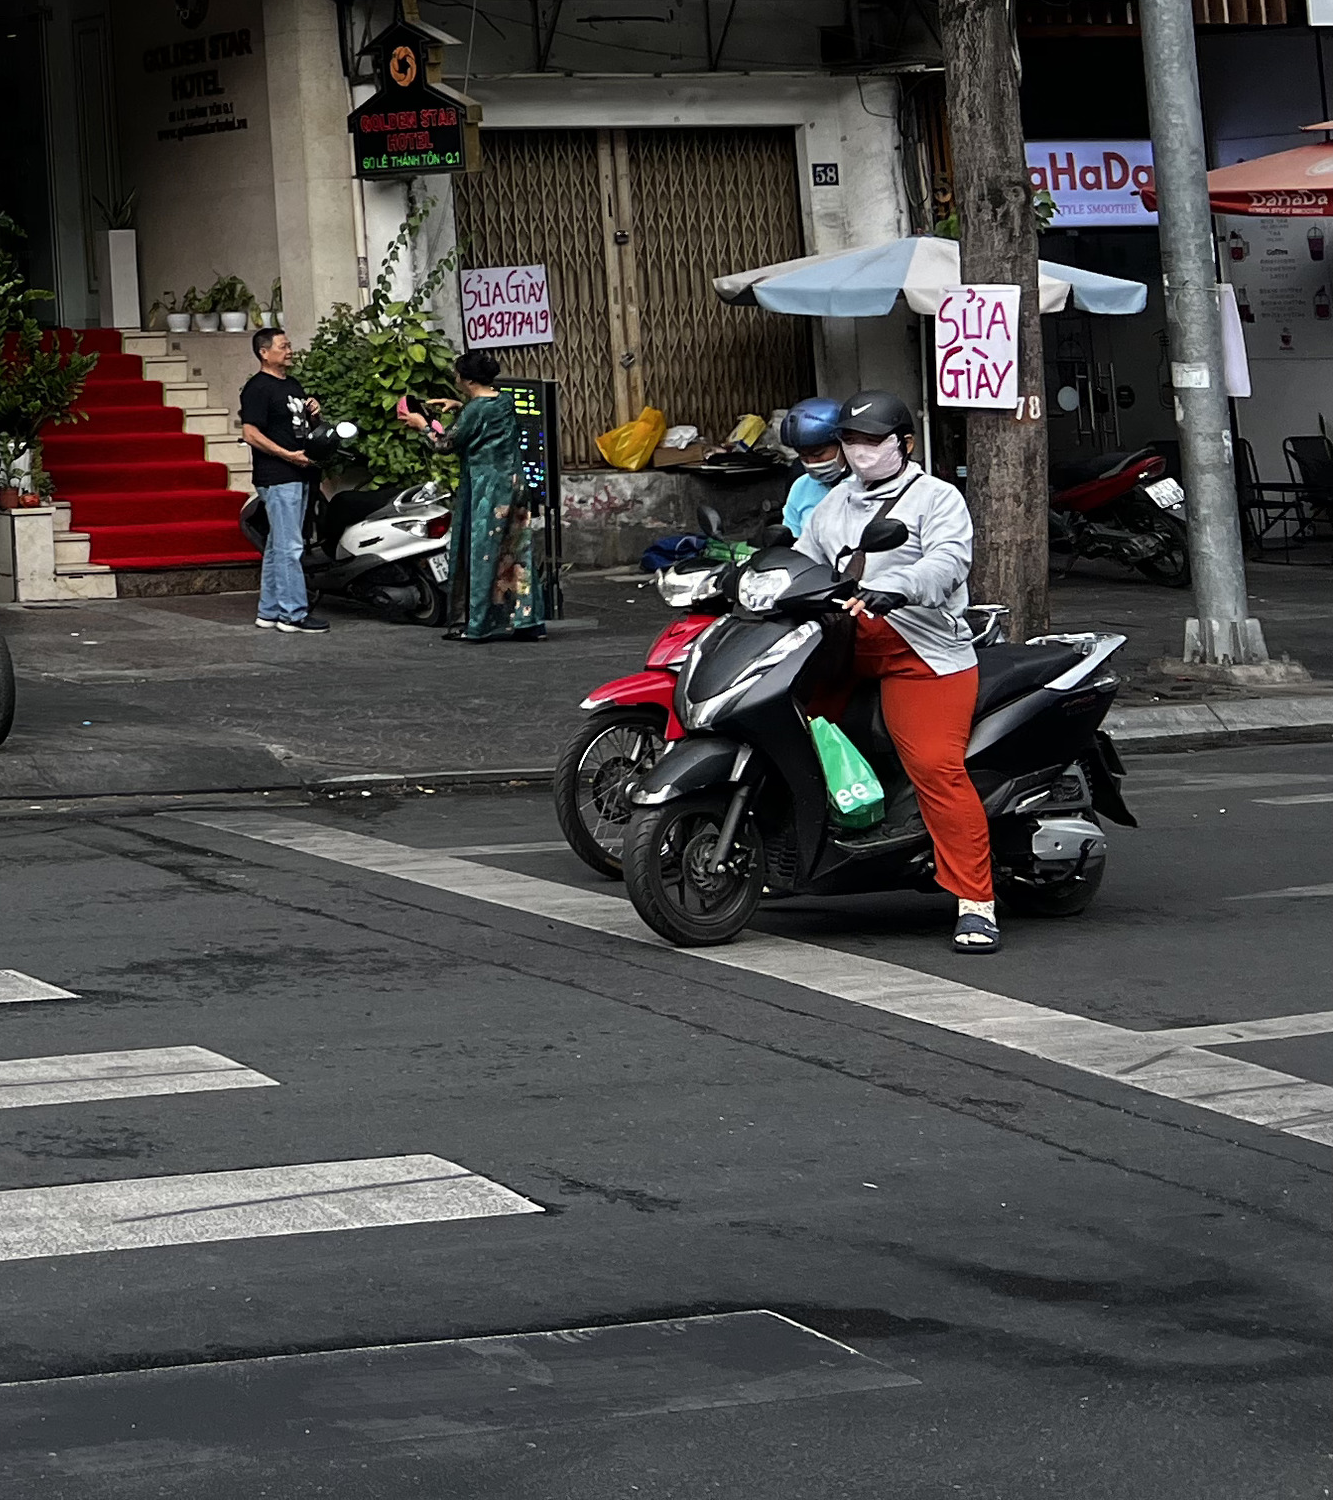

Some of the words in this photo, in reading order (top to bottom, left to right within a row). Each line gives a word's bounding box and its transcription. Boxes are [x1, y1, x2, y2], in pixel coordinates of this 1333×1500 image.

[387, 131, 434, 152] HOTEL
[816, 166, 837, 184] 58
[1028, 151, 1155, 190] aHaDa
[1058, 204, 1084, 215] TYLE
[464, 274, 505, 311] SỬA
[938, 288, 1011, 349] SỬA
[1015, 395, 1041, 420] 78
